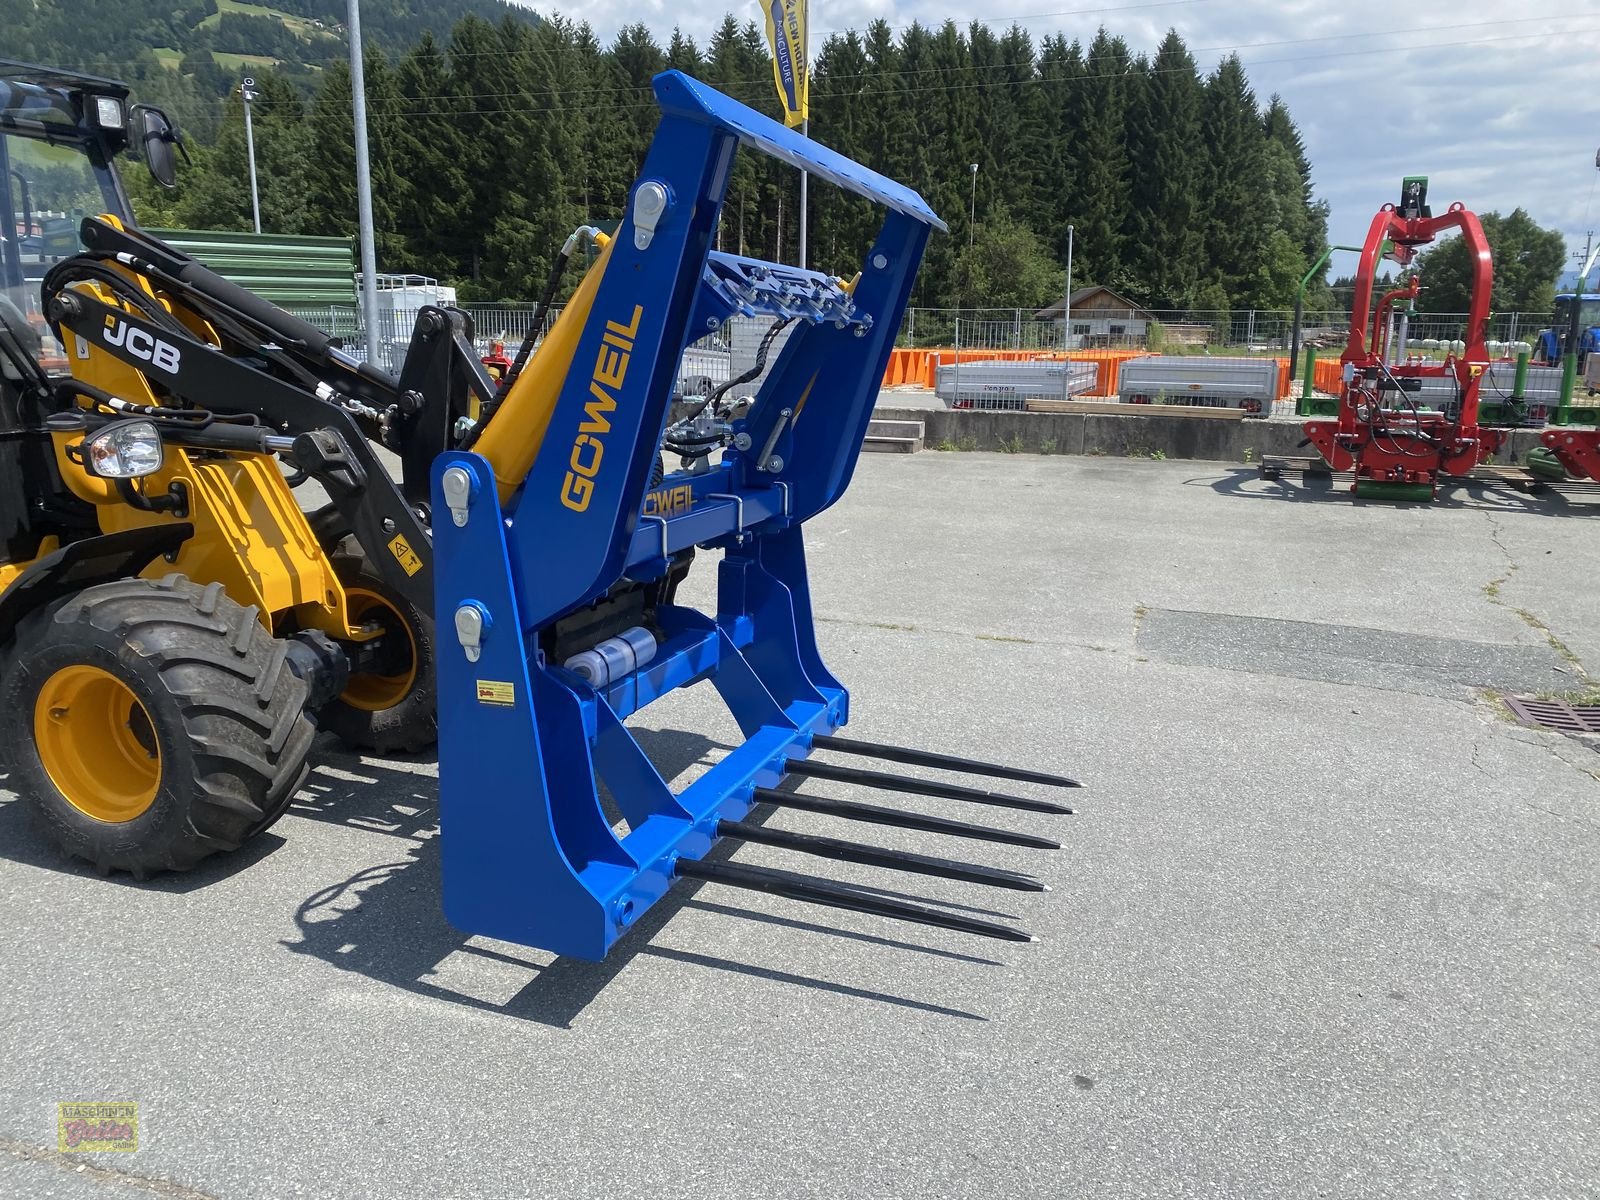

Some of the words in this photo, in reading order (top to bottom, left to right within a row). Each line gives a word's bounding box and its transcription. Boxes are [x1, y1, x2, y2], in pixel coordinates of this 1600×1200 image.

[776, 20, 792, 84] AGRICULTURE
[786, 12, 800, 40] NEW
[102, 320, 182, 375] JCB
